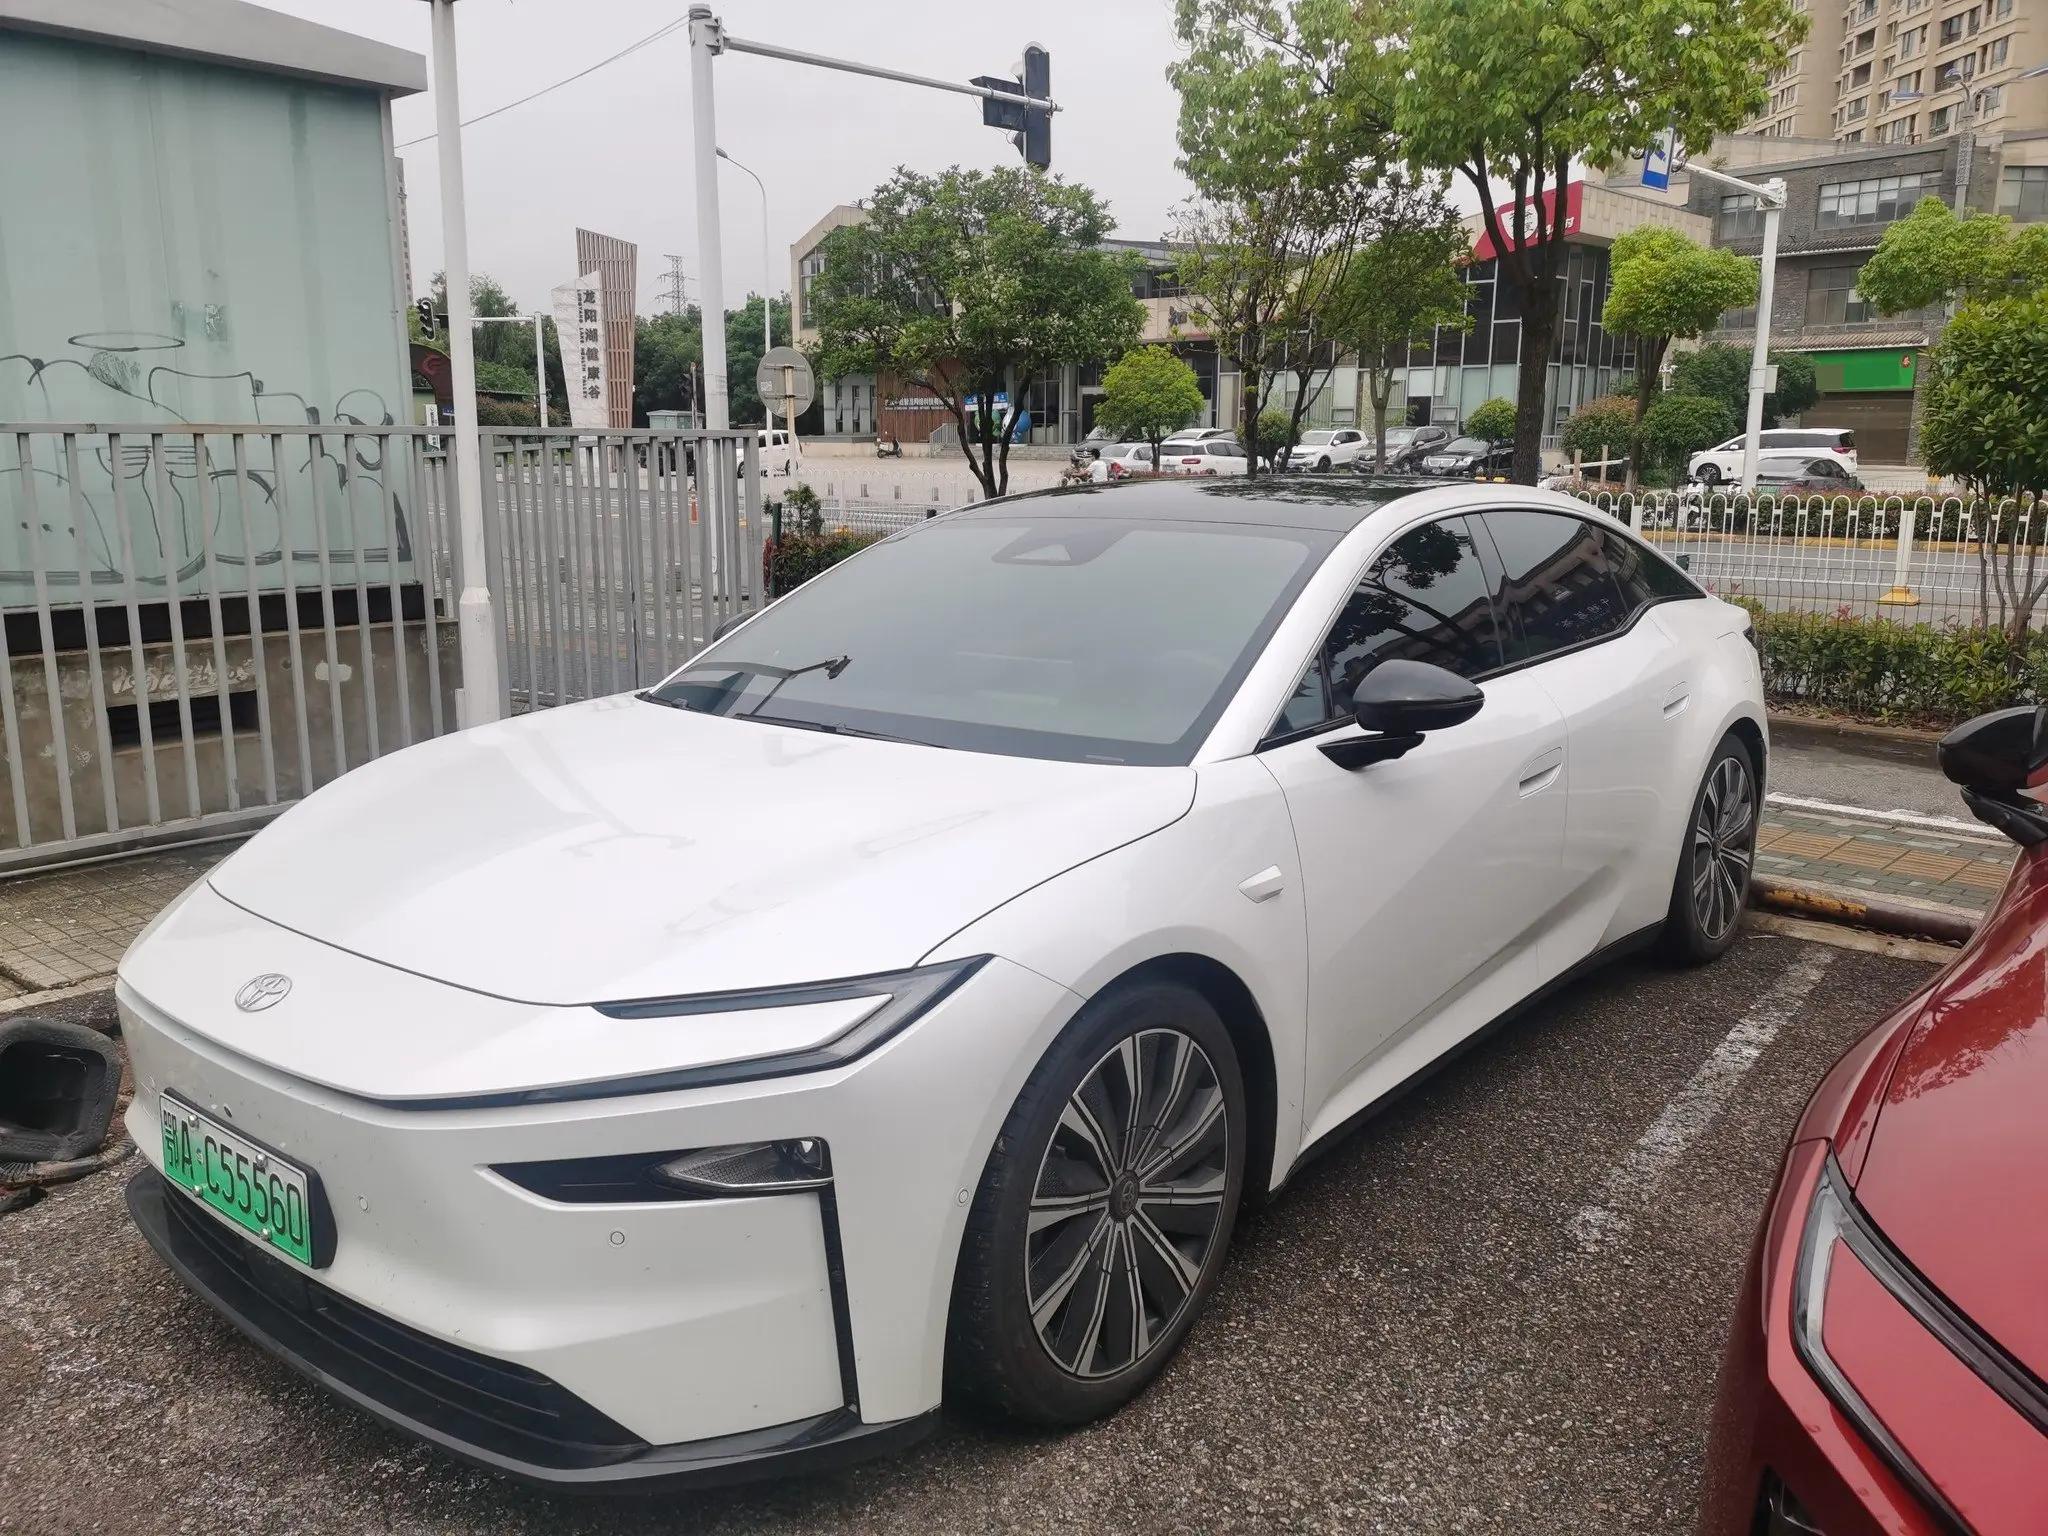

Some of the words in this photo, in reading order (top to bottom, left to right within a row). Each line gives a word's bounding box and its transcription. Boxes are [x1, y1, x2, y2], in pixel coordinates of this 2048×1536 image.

[583, 289, 600, 399] 龙阳湖健康谷
